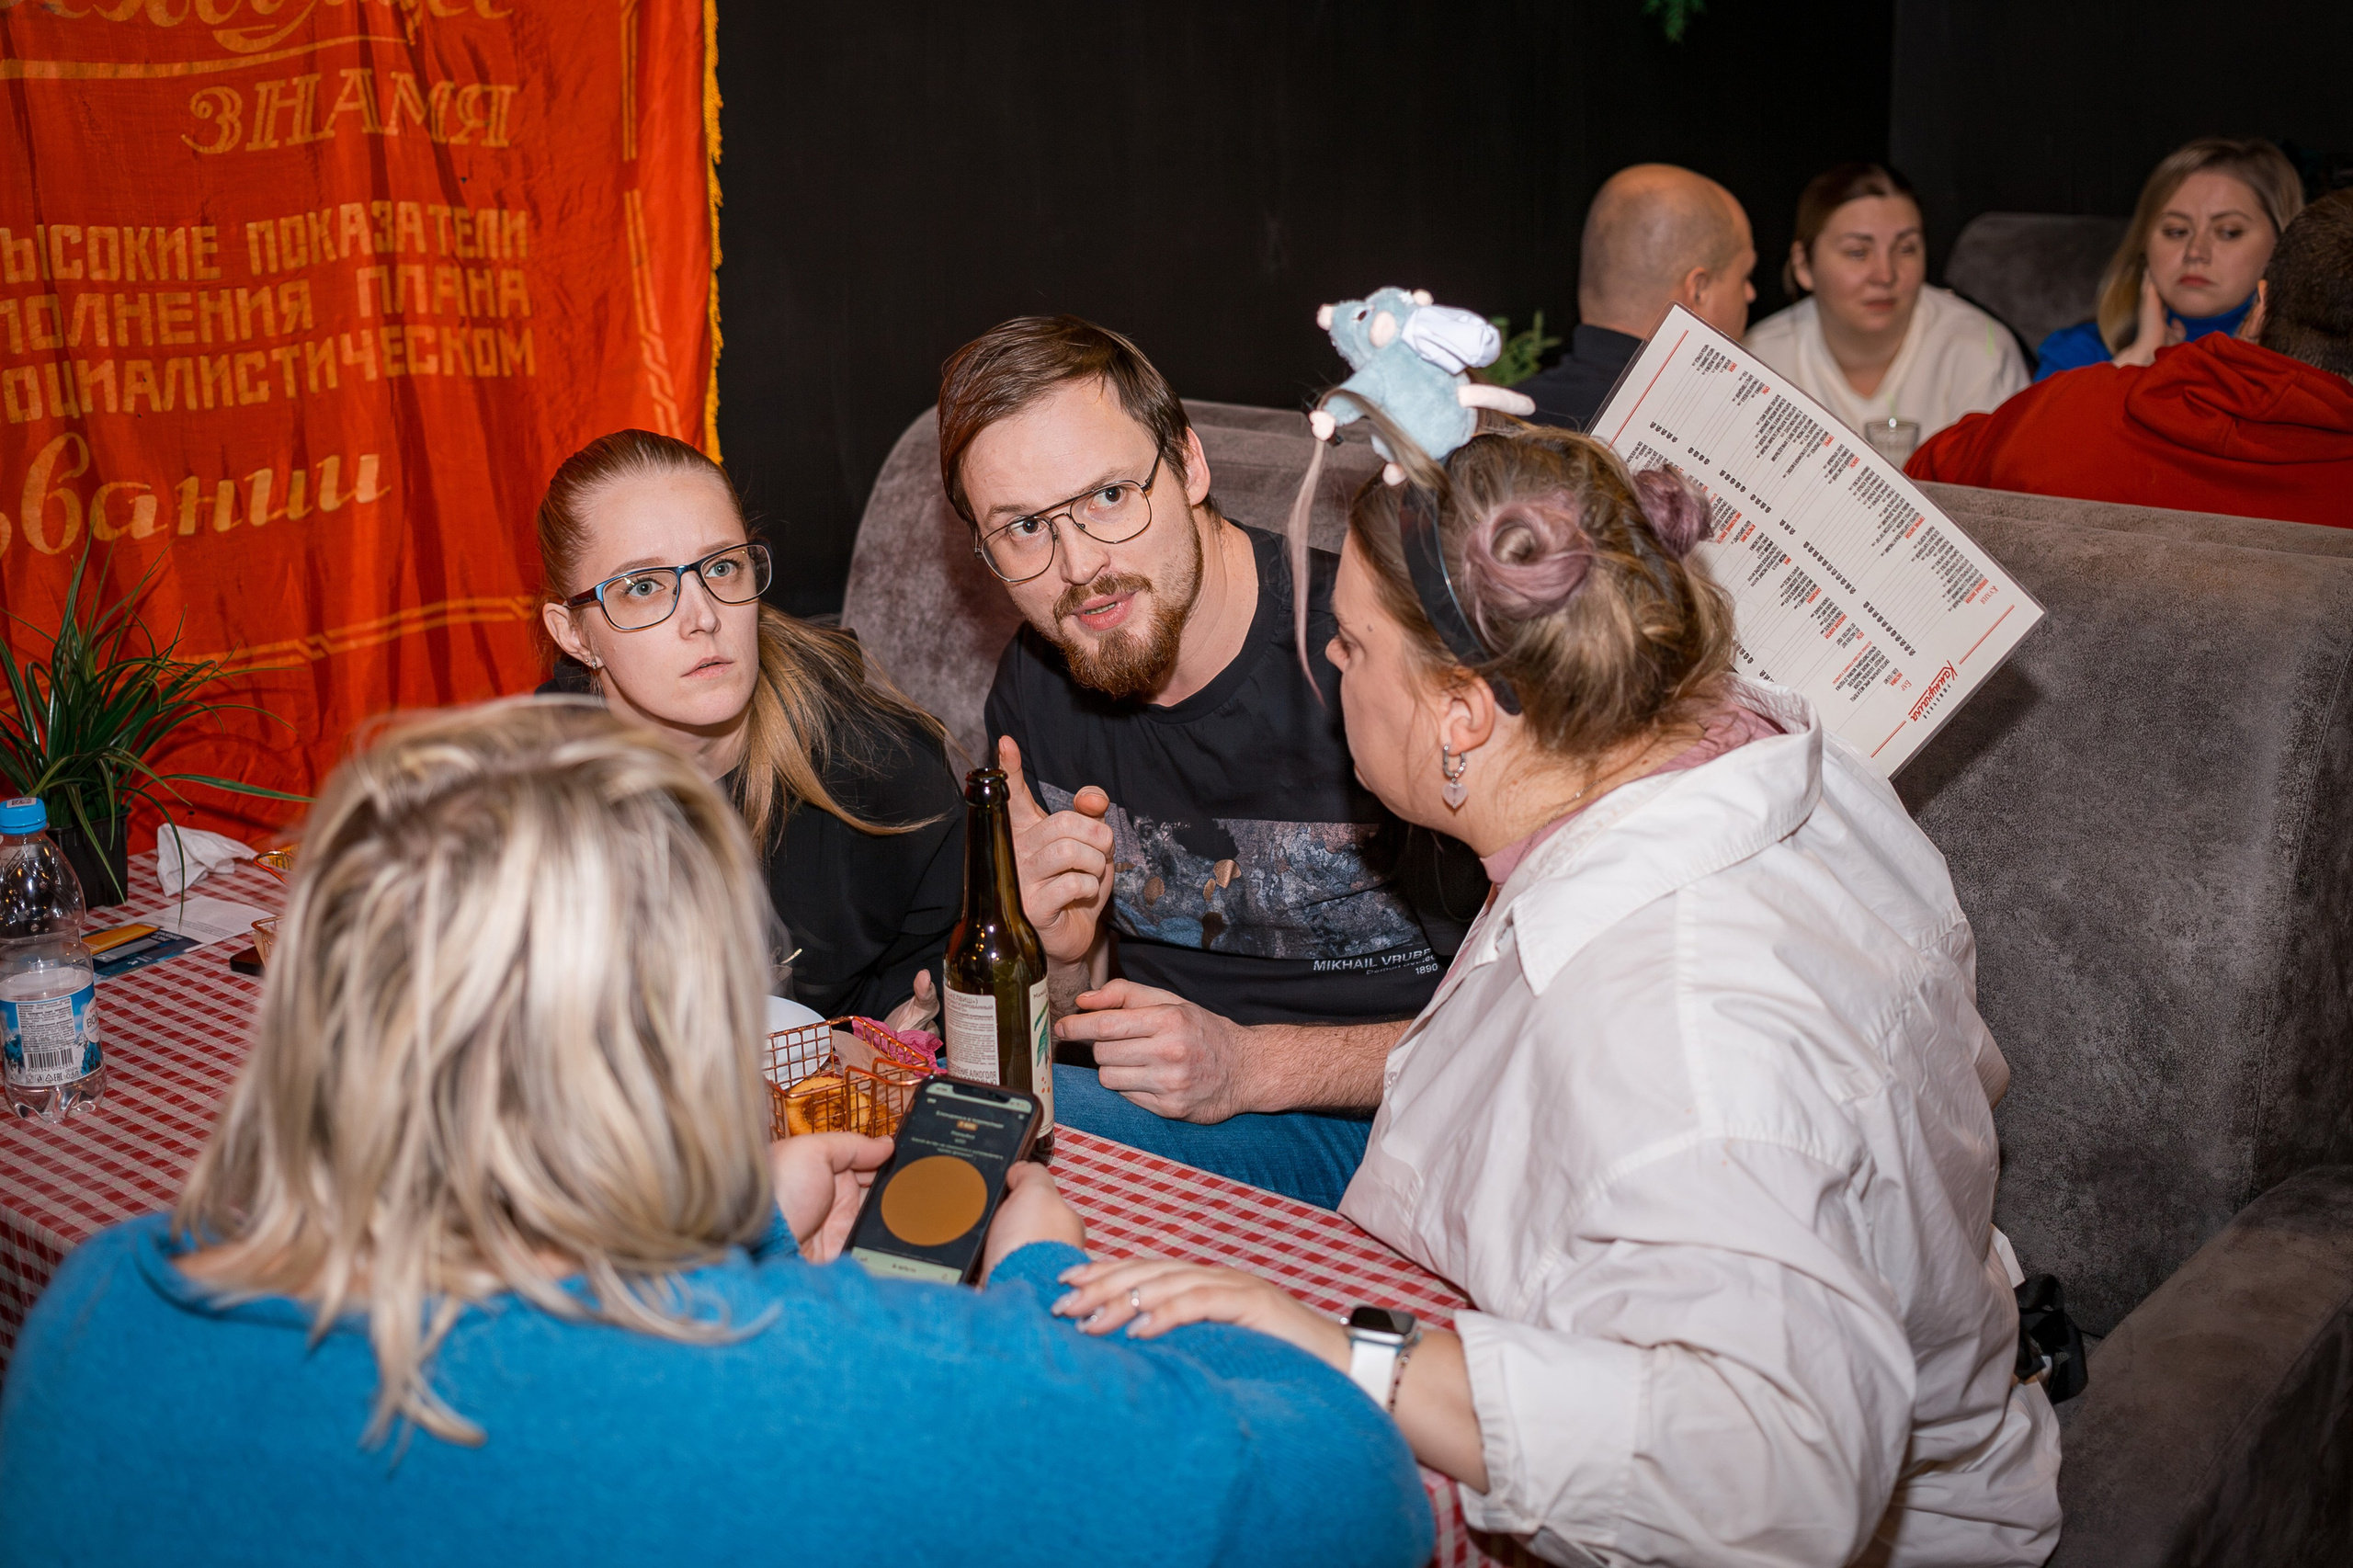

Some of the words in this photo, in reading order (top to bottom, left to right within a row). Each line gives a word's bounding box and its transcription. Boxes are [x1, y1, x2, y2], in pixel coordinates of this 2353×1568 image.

[181, 67, 518, 154] ЗНАМЯ
[245, 199, 529, 276] ПОКАЗАТЕЛИ
[356, 264, 531, 319] ПЛАНА
[2, 324, 537, 424] ОЦИАЛИСТИЧЕСКОМ
[1313, 958, 1378, 971] MIKHAIL
[1381, 948, 1432, 966] VRUBE
[1415, 962, 1438, 975] 1890
[970, 1069, 997, 1080] АЛКОГОЛЯ
